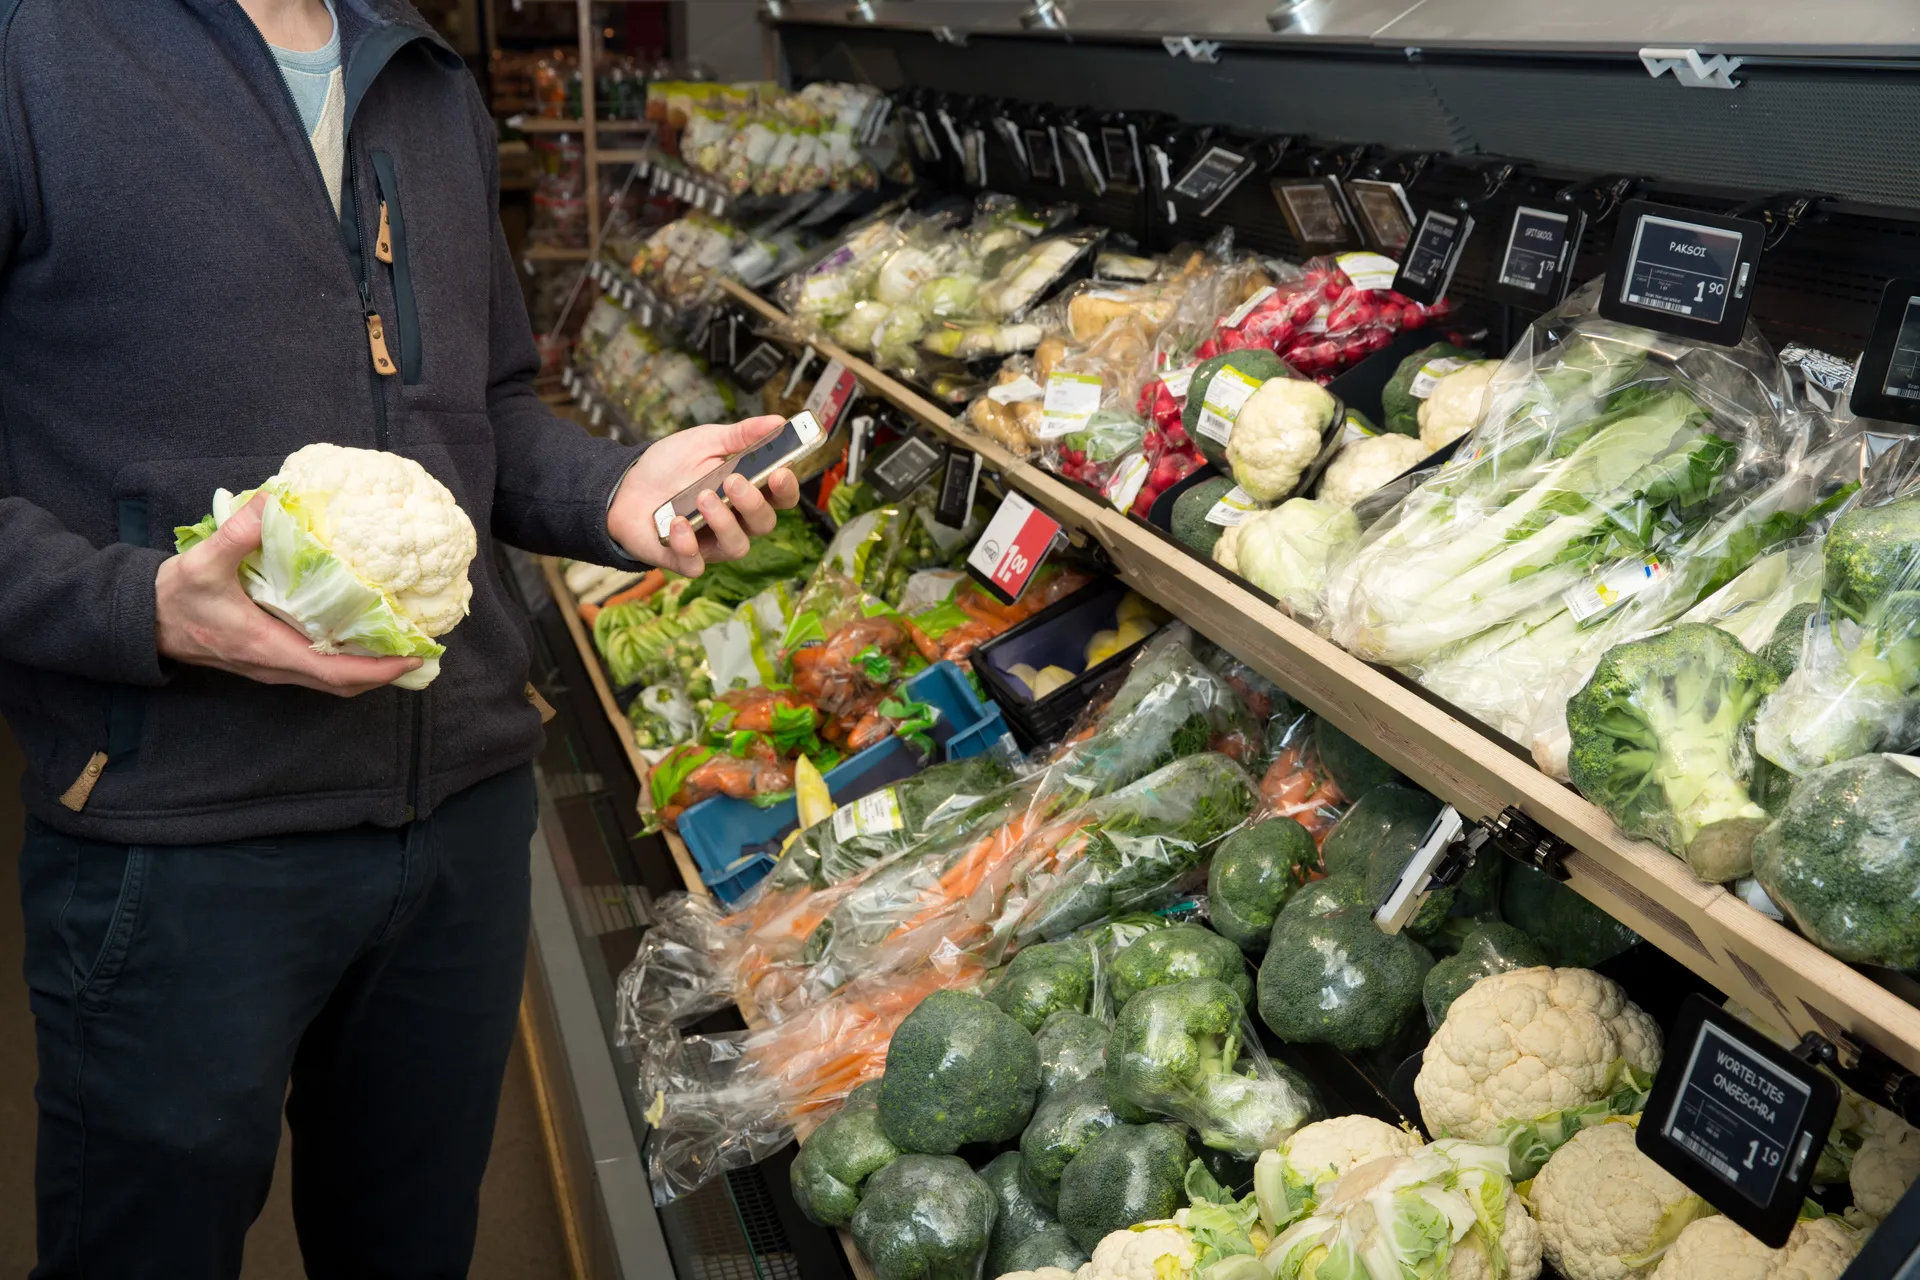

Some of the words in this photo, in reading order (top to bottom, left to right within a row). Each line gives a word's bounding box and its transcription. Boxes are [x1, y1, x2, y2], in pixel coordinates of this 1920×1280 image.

[1669, 241, 1707, 258] PAKSOI
[997, 544, 1028, 583] 1.00
[1713, 1073, 1776, 1124] ONGESCHRA
[1716, 1049, 1785, 1105] WORTELTJES
